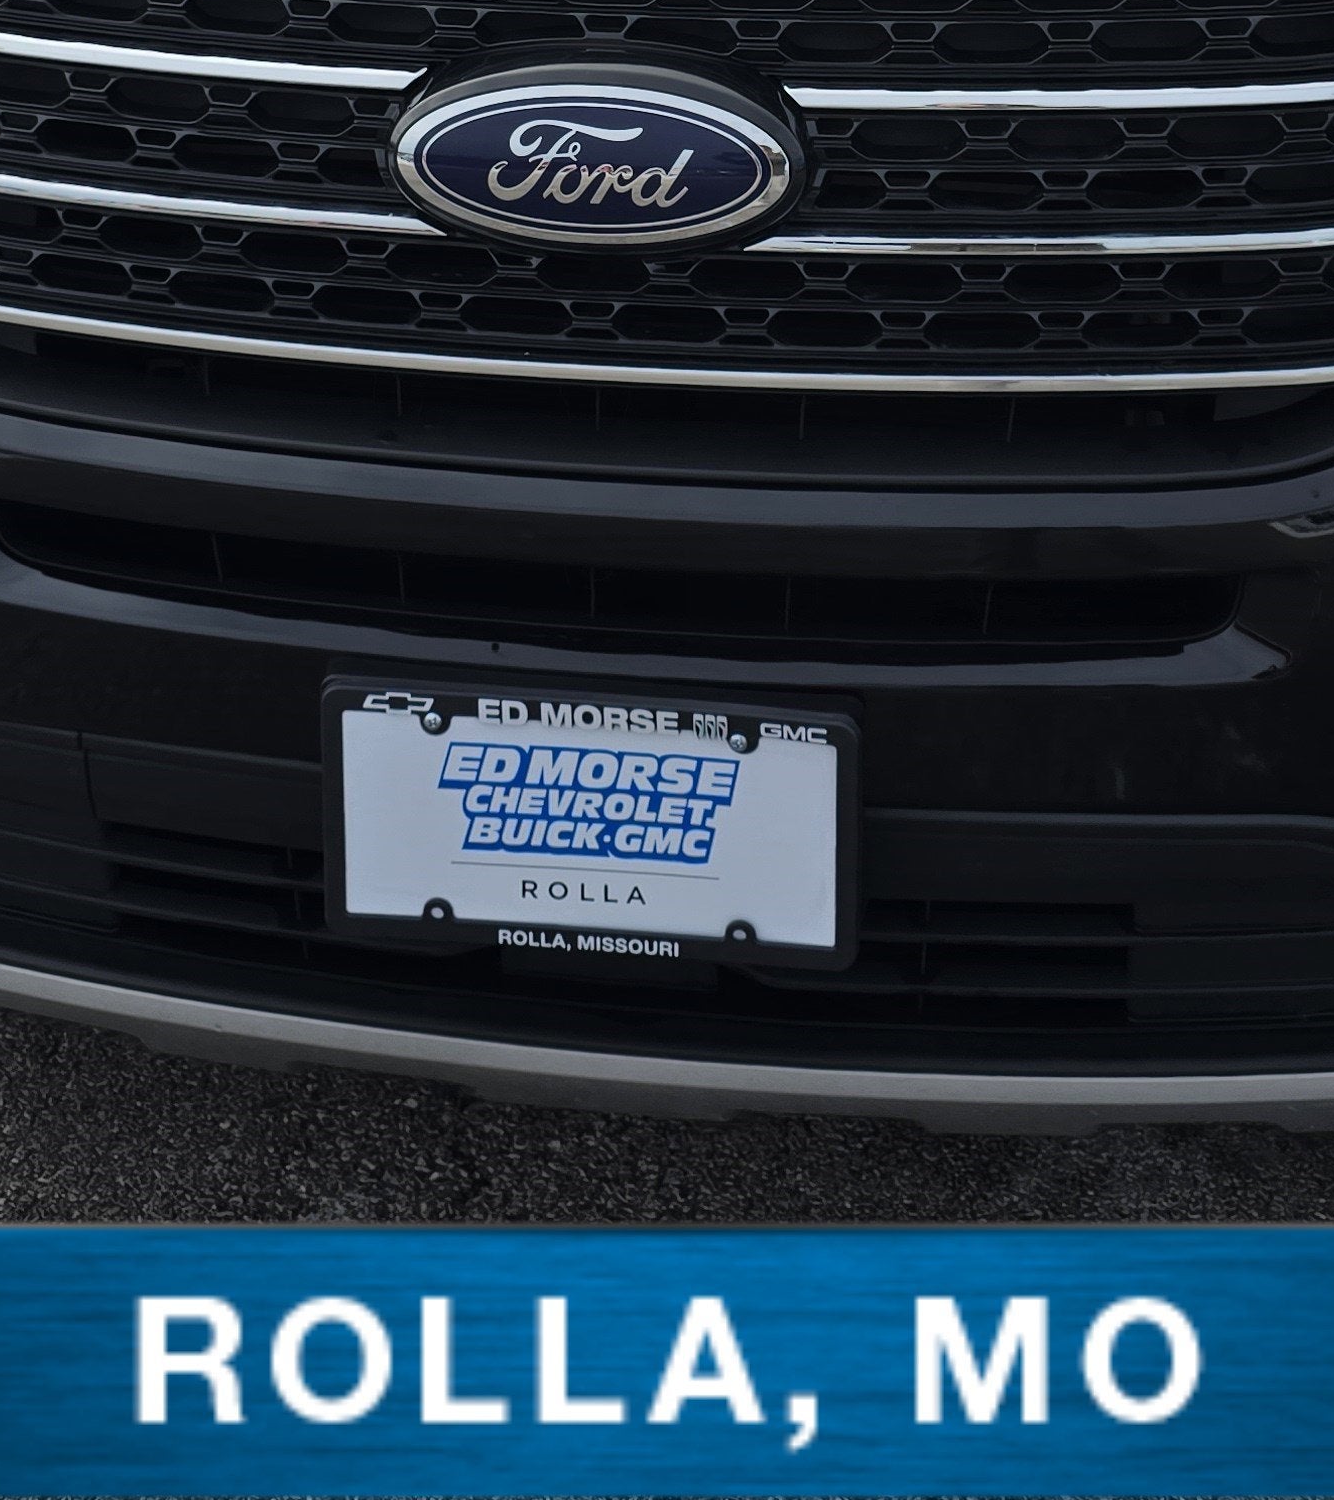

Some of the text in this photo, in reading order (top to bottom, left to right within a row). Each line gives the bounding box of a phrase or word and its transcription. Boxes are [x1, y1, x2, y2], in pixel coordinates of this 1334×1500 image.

[487, 118, 695, 208] Ford
[477, 698, 828, 744] ED MORSE GMC
[442, 744, 736, 798] ED MORSE
[465, 784, 714, 827] CHEVROLET
[521, 879, 647, 906] ROLLA
[497, 928, 681, 958] ROLLA, MISSOURI
